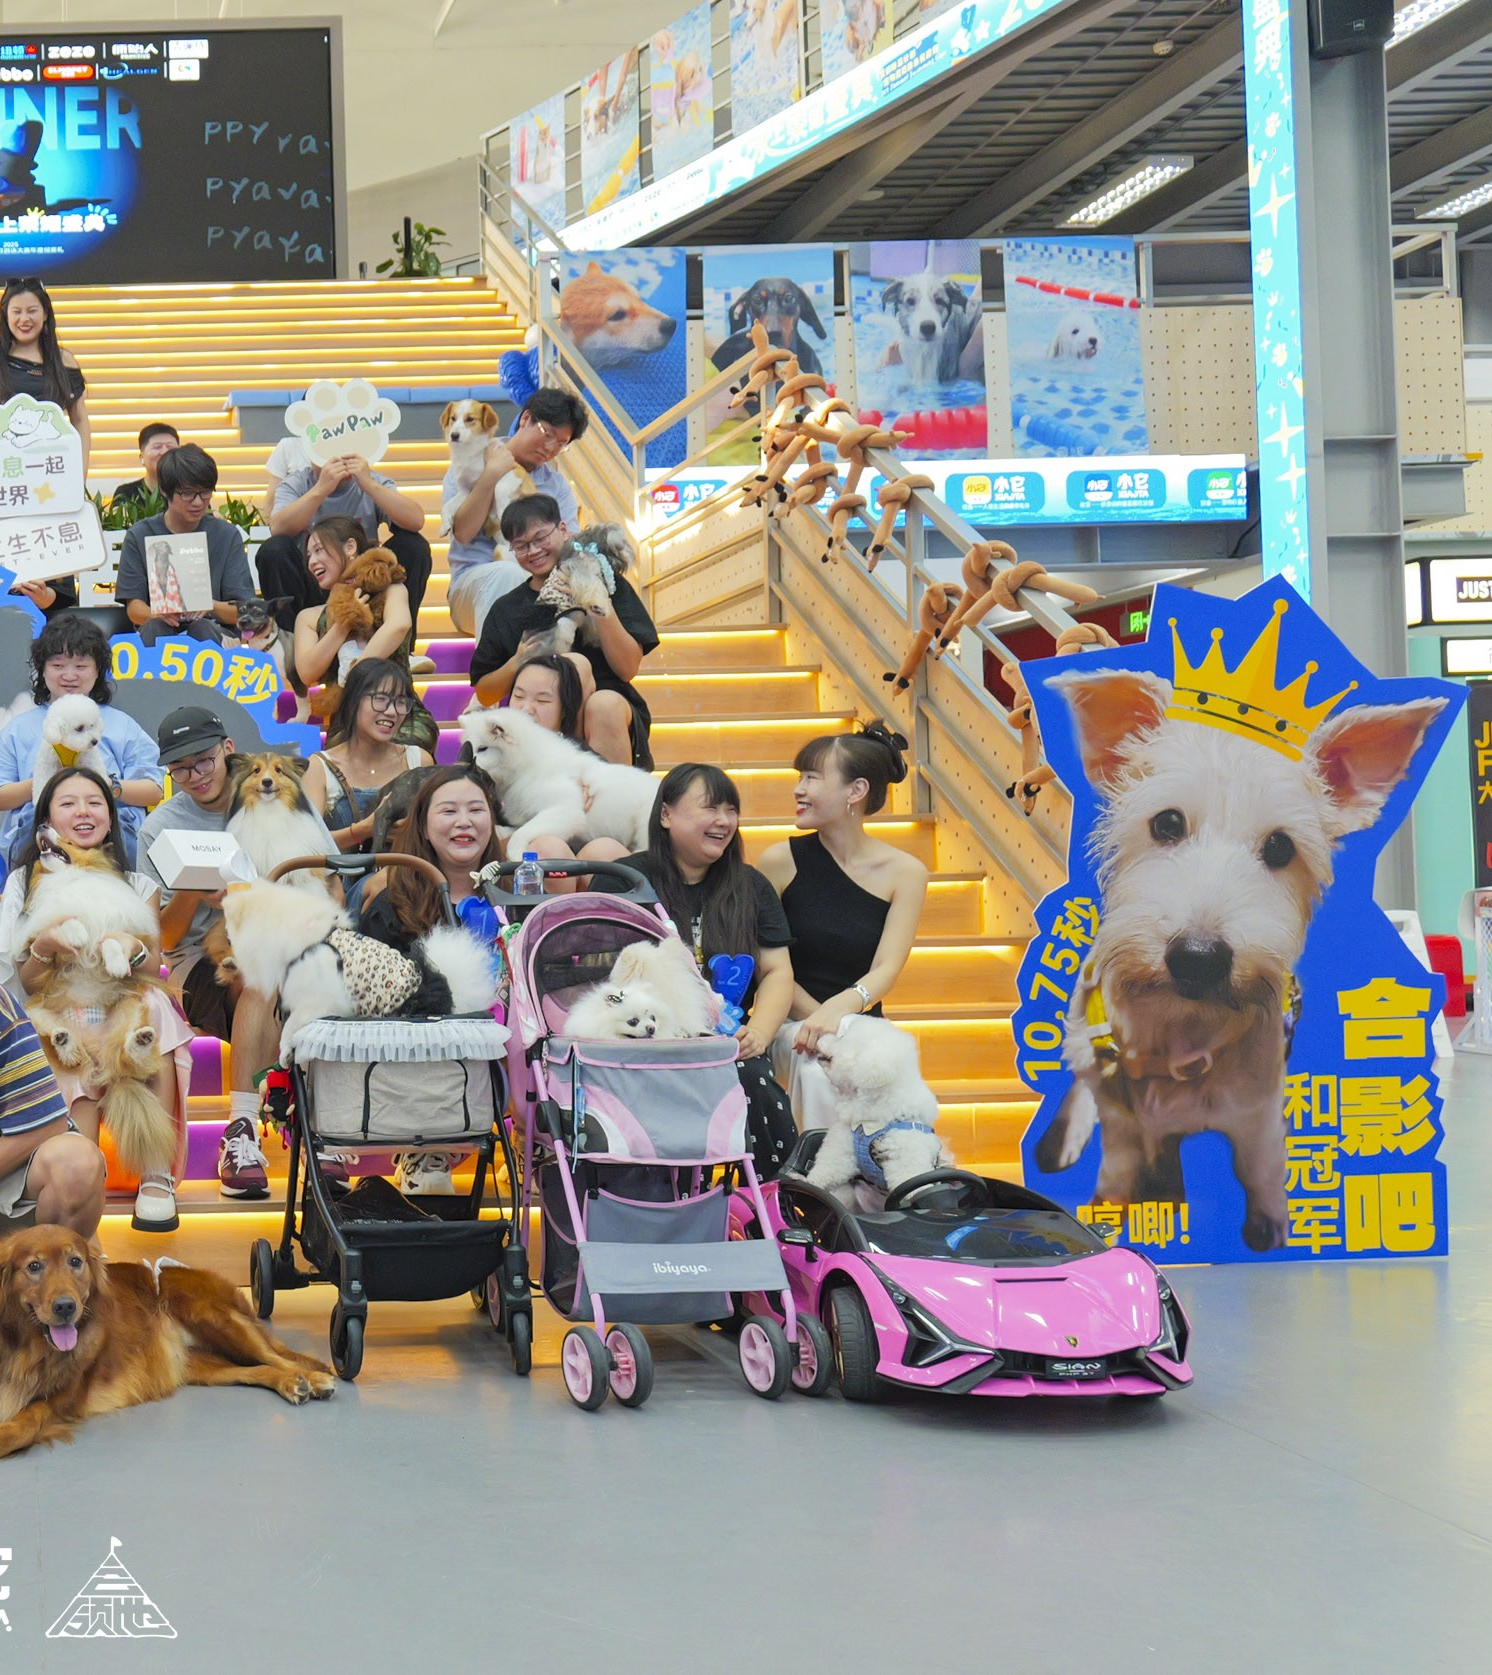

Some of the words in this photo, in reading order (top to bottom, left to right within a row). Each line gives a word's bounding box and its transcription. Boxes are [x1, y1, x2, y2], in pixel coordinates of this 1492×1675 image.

[993, 475, 1026, 493] 小它
[1116, 473, 1150, 490] 小它
[191, 844, 222, 854] MOSAY
[1022, 895, 1100, 1081] 10.75秒
[1336, 976, 1438, 1253] 合影吧
[1282, 1072, 1342, 1255] 和冠军
[652, 1260, 709, 1276] ibiyaya
